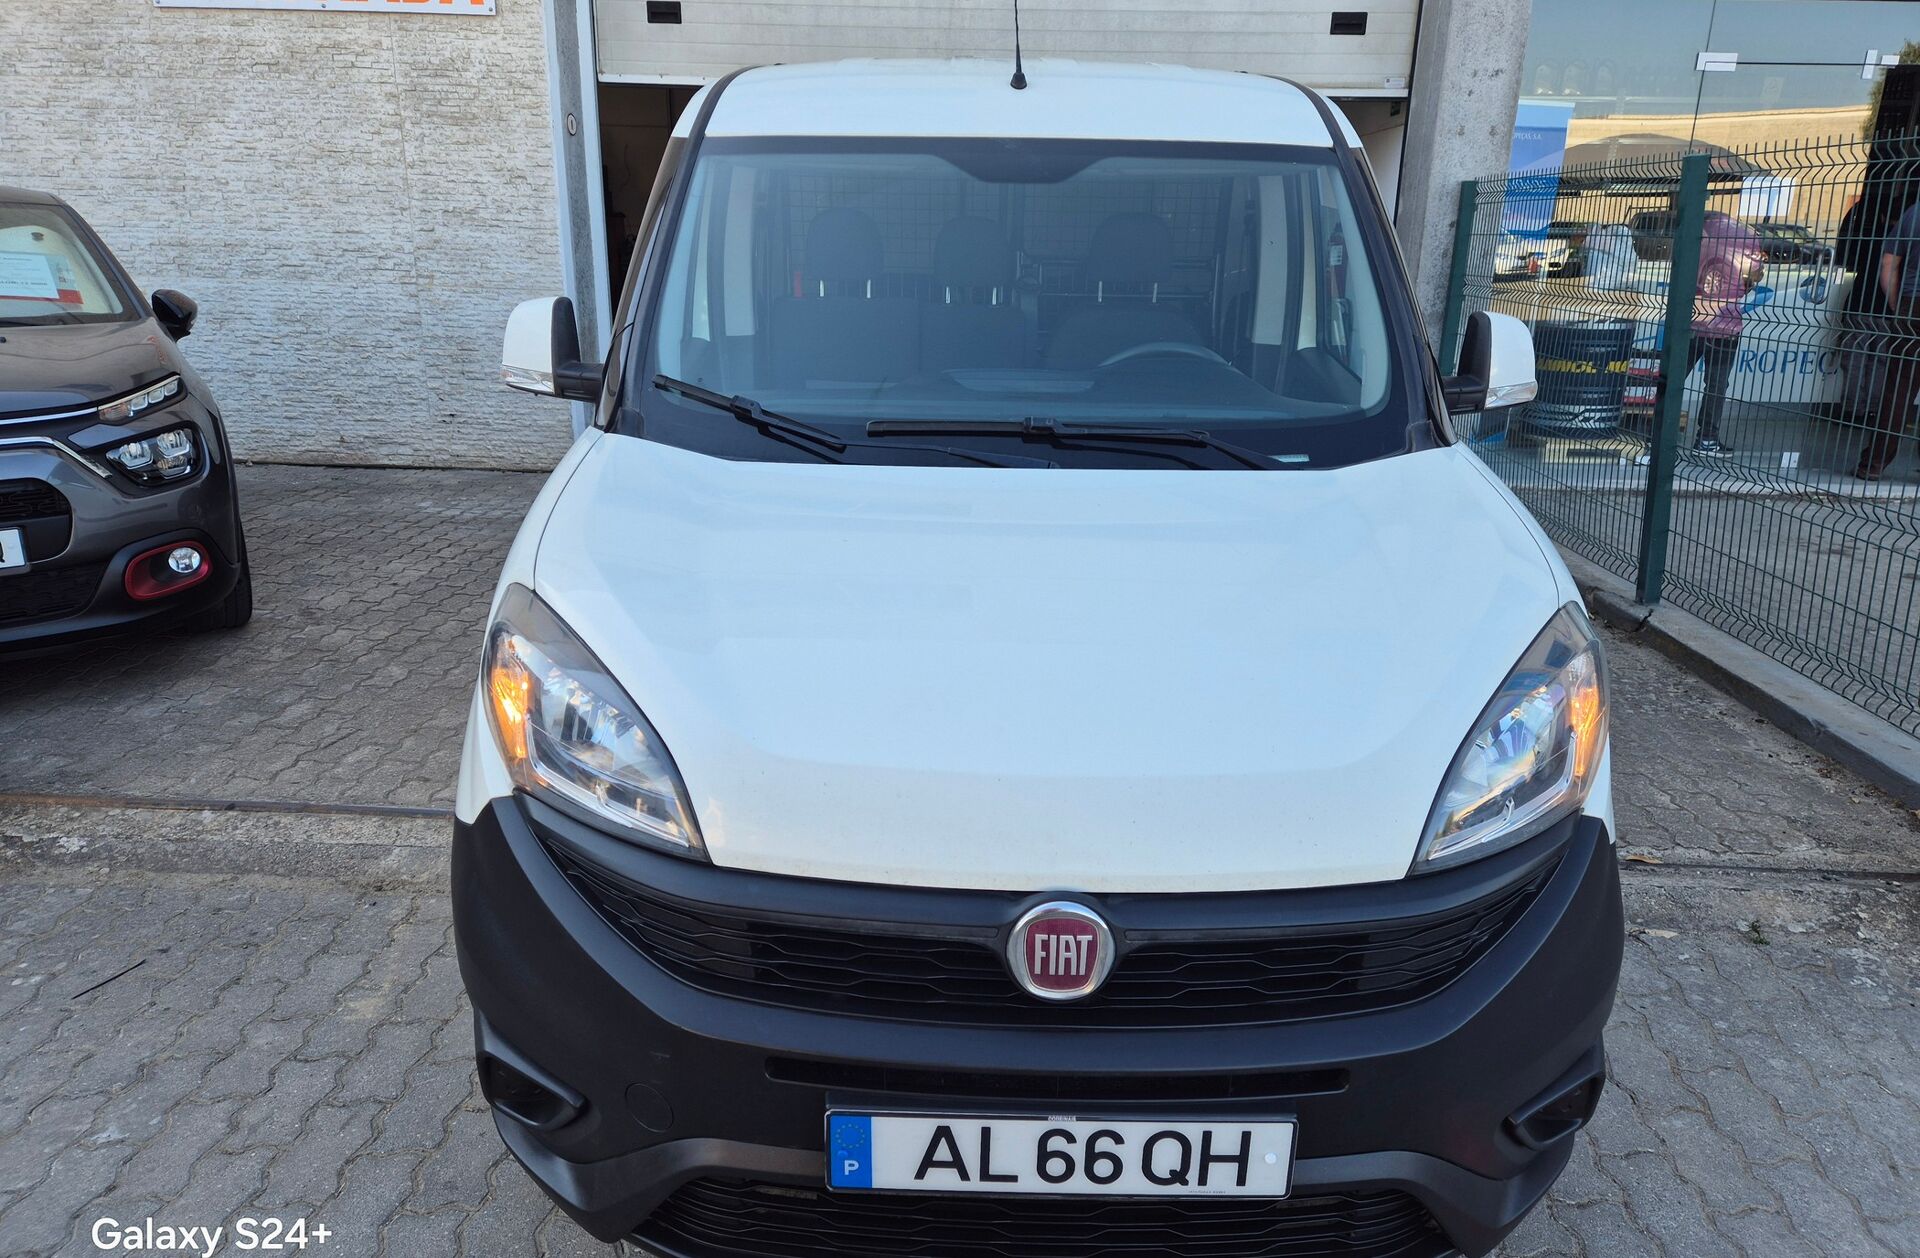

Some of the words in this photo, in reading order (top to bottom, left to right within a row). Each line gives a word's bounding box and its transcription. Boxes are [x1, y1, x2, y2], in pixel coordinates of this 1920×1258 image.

[1034, 933, 1093, 975] FIAT
[843, 1159, 860, 1176] P
[914, 1125, 1018, 1183] AL
[1037, 1128, 1124, 1185] 66
[1141, 1130, 1252, 1187] QH
